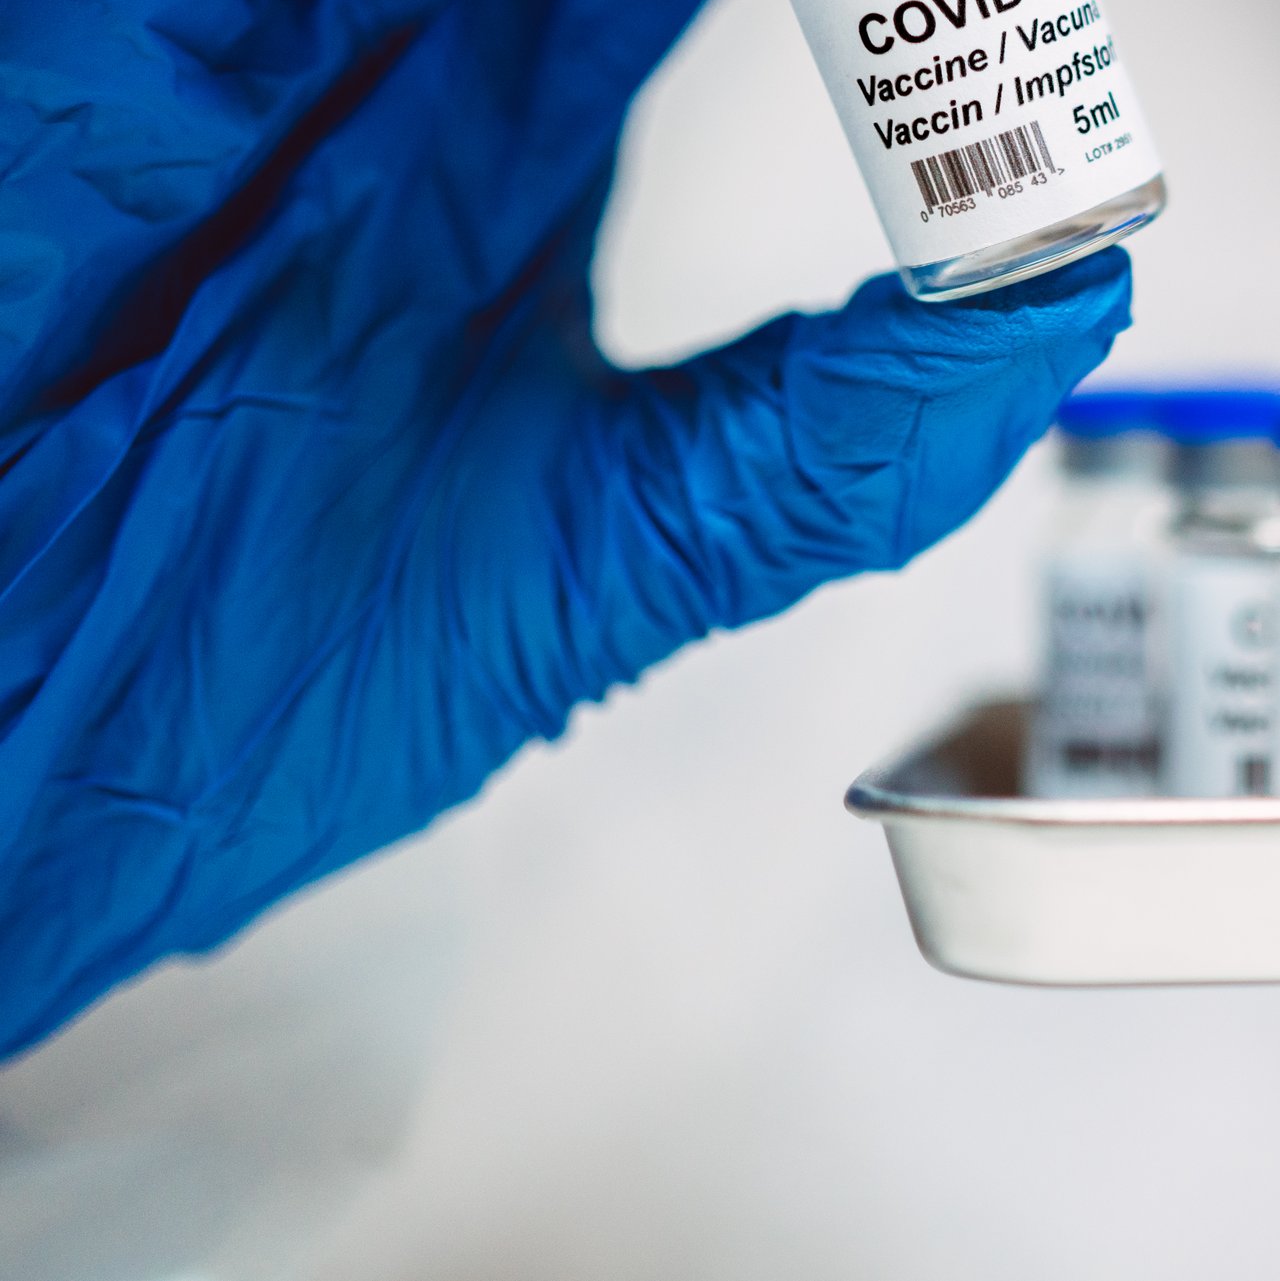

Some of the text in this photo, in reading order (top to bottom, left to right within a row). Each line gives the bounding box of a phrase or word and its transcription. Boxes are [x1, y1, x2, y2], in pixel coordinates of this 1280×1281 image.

[857, 49, 988, 107] Vaccine
[999, 31, 1007, 65] /
[874, 99, 983, 150] Vaccin
[995, 82, 1003, 115] /
[1072, 91, 1120, 134] 5ml
[1085, 141, 1114, 164] LOT#
[920, 172, 1048, 223] 0 70563 085 43
